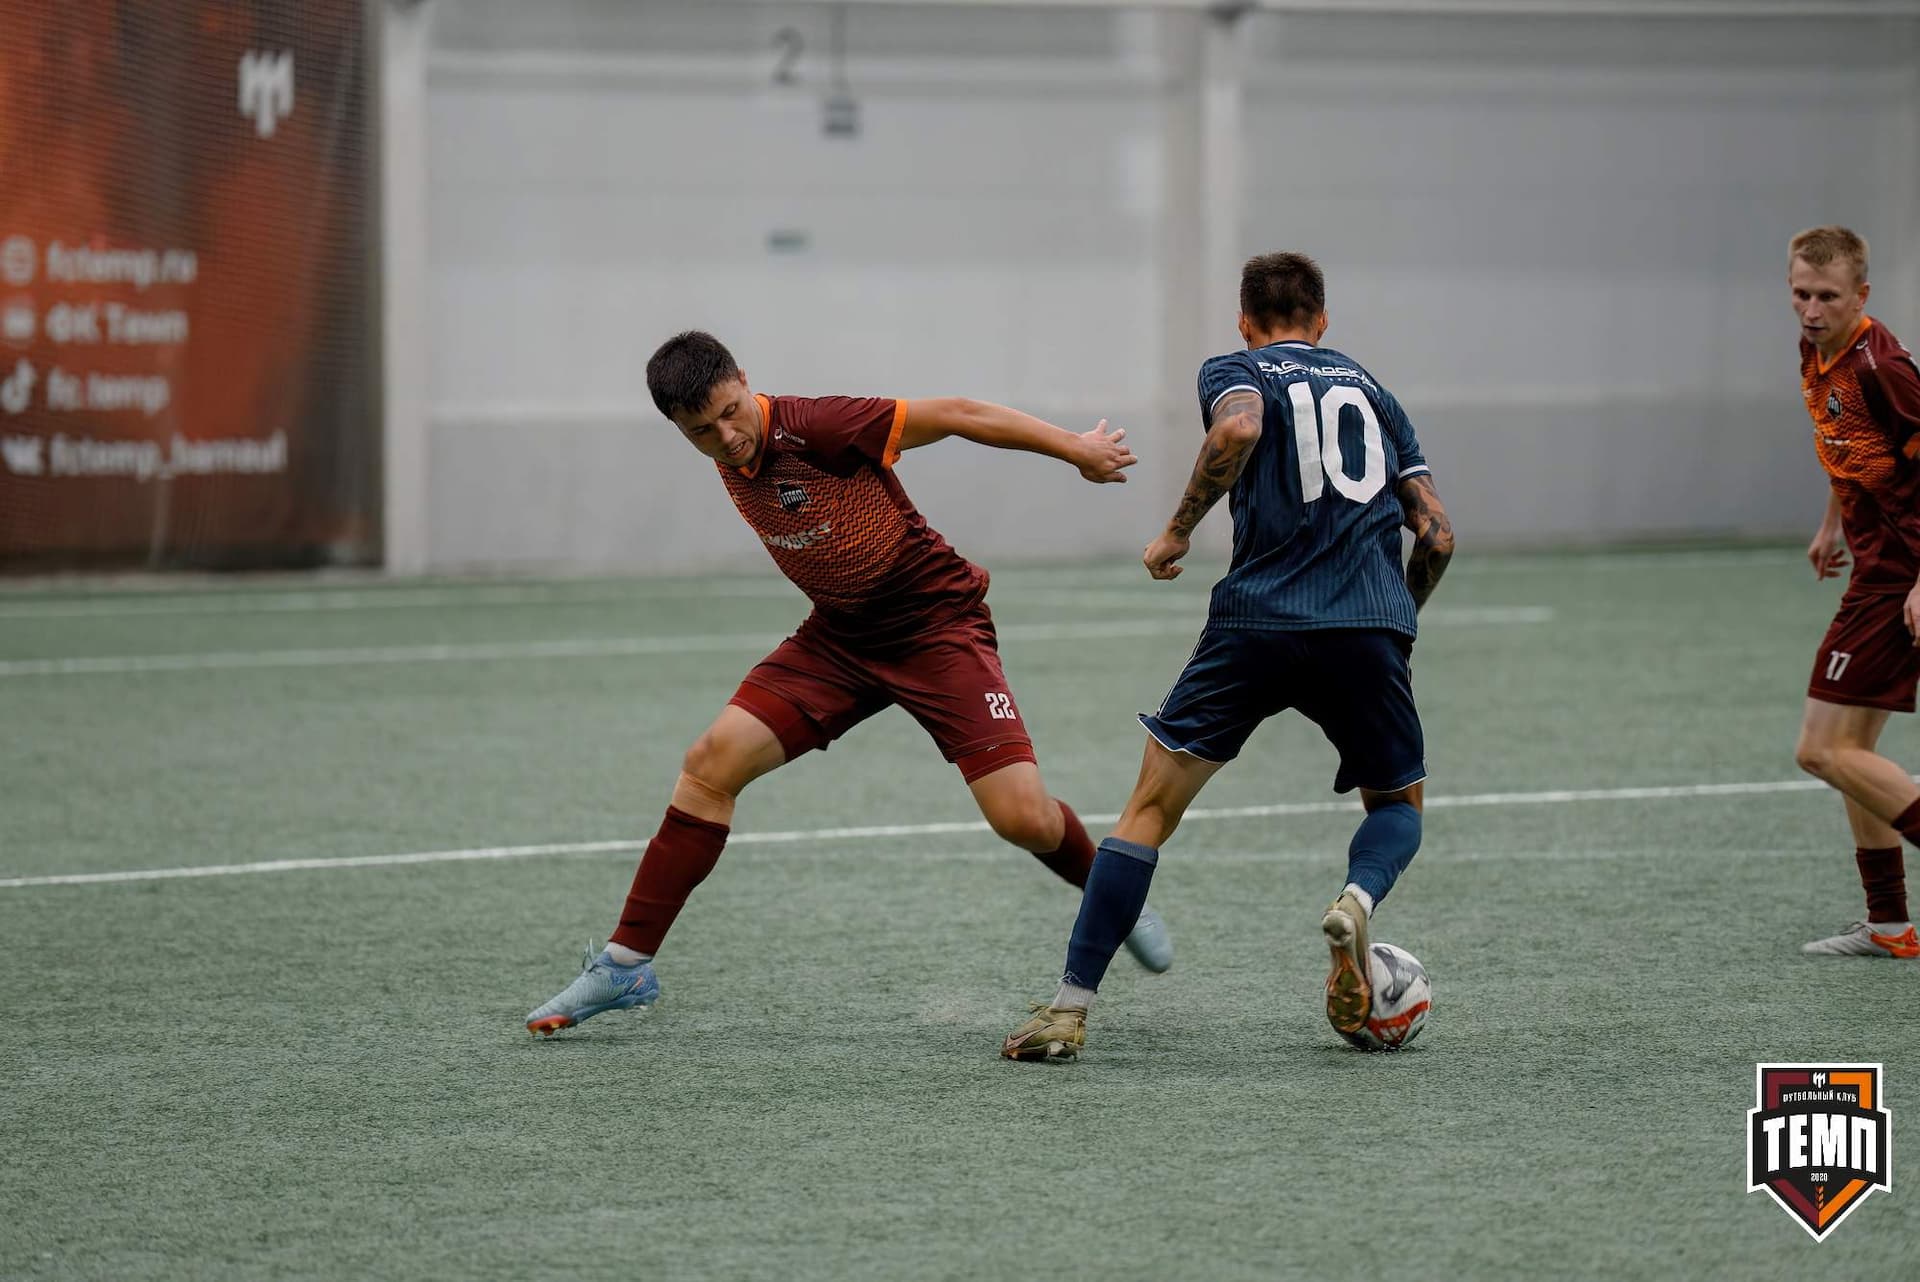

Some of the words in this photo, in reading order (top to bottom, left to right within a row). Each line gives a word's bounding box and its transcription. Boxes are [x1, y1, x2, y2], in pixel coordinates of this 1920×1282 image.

[769, 24, 805, 89] 2
[46, 239, 198, 290] fctemp.ru
[46, 303, 101, 344] ФК
[46, 367, 170, 415] fc.temp
[1287, 381, 1386, 504] 10
[1825, 650, 1852, 681] 17
[984, 692, 1017, 720] 22
